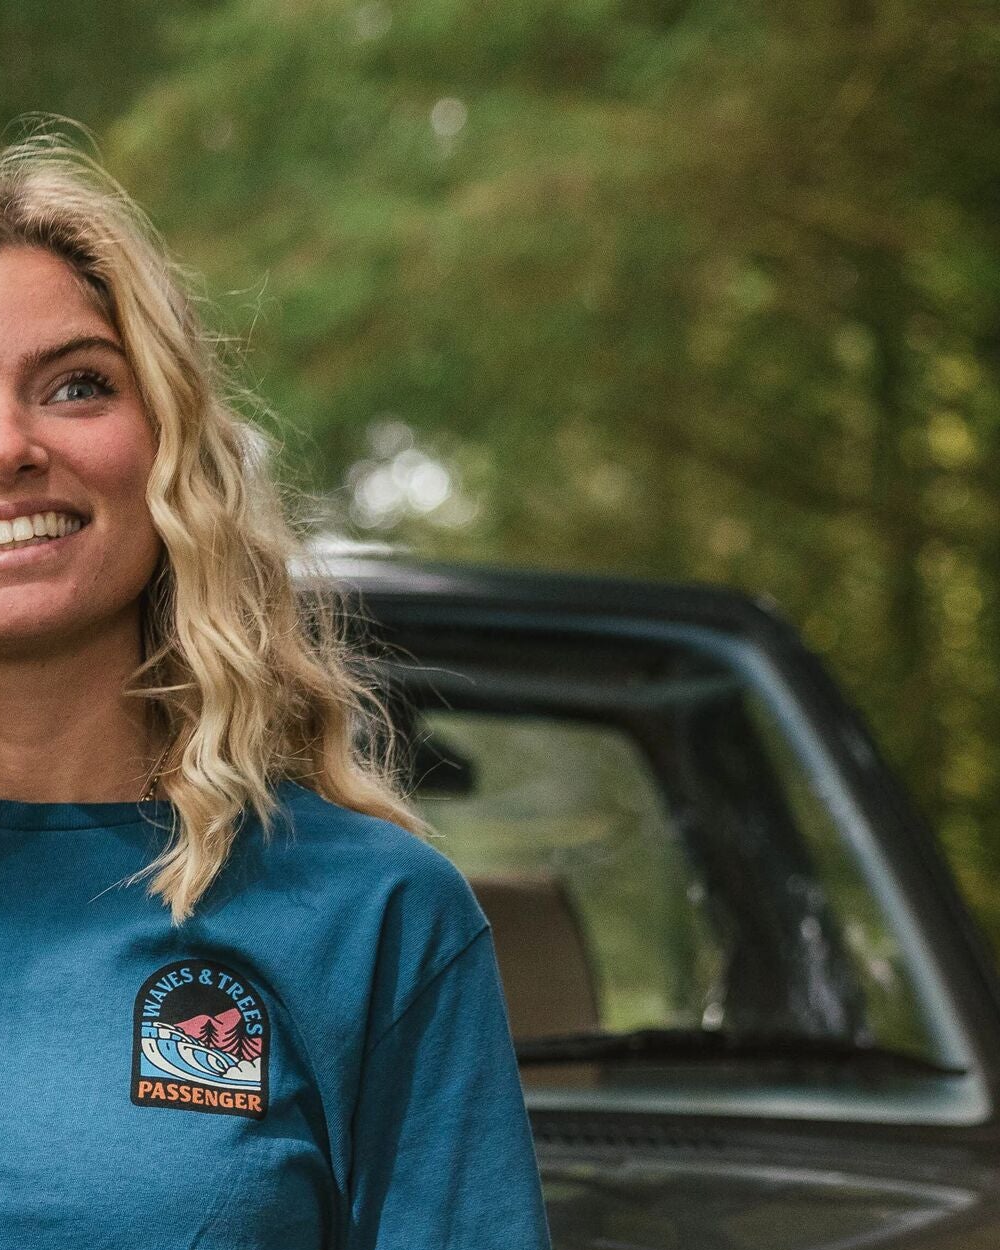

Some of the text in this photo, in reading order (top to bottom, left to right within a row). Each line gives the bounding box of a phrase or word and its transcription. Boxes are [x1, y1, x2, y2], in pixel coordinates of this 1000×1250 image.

[143, 967, 263, 1038] WAVES & TREES
[137, 1080, 263, 1112] PASSENGER
